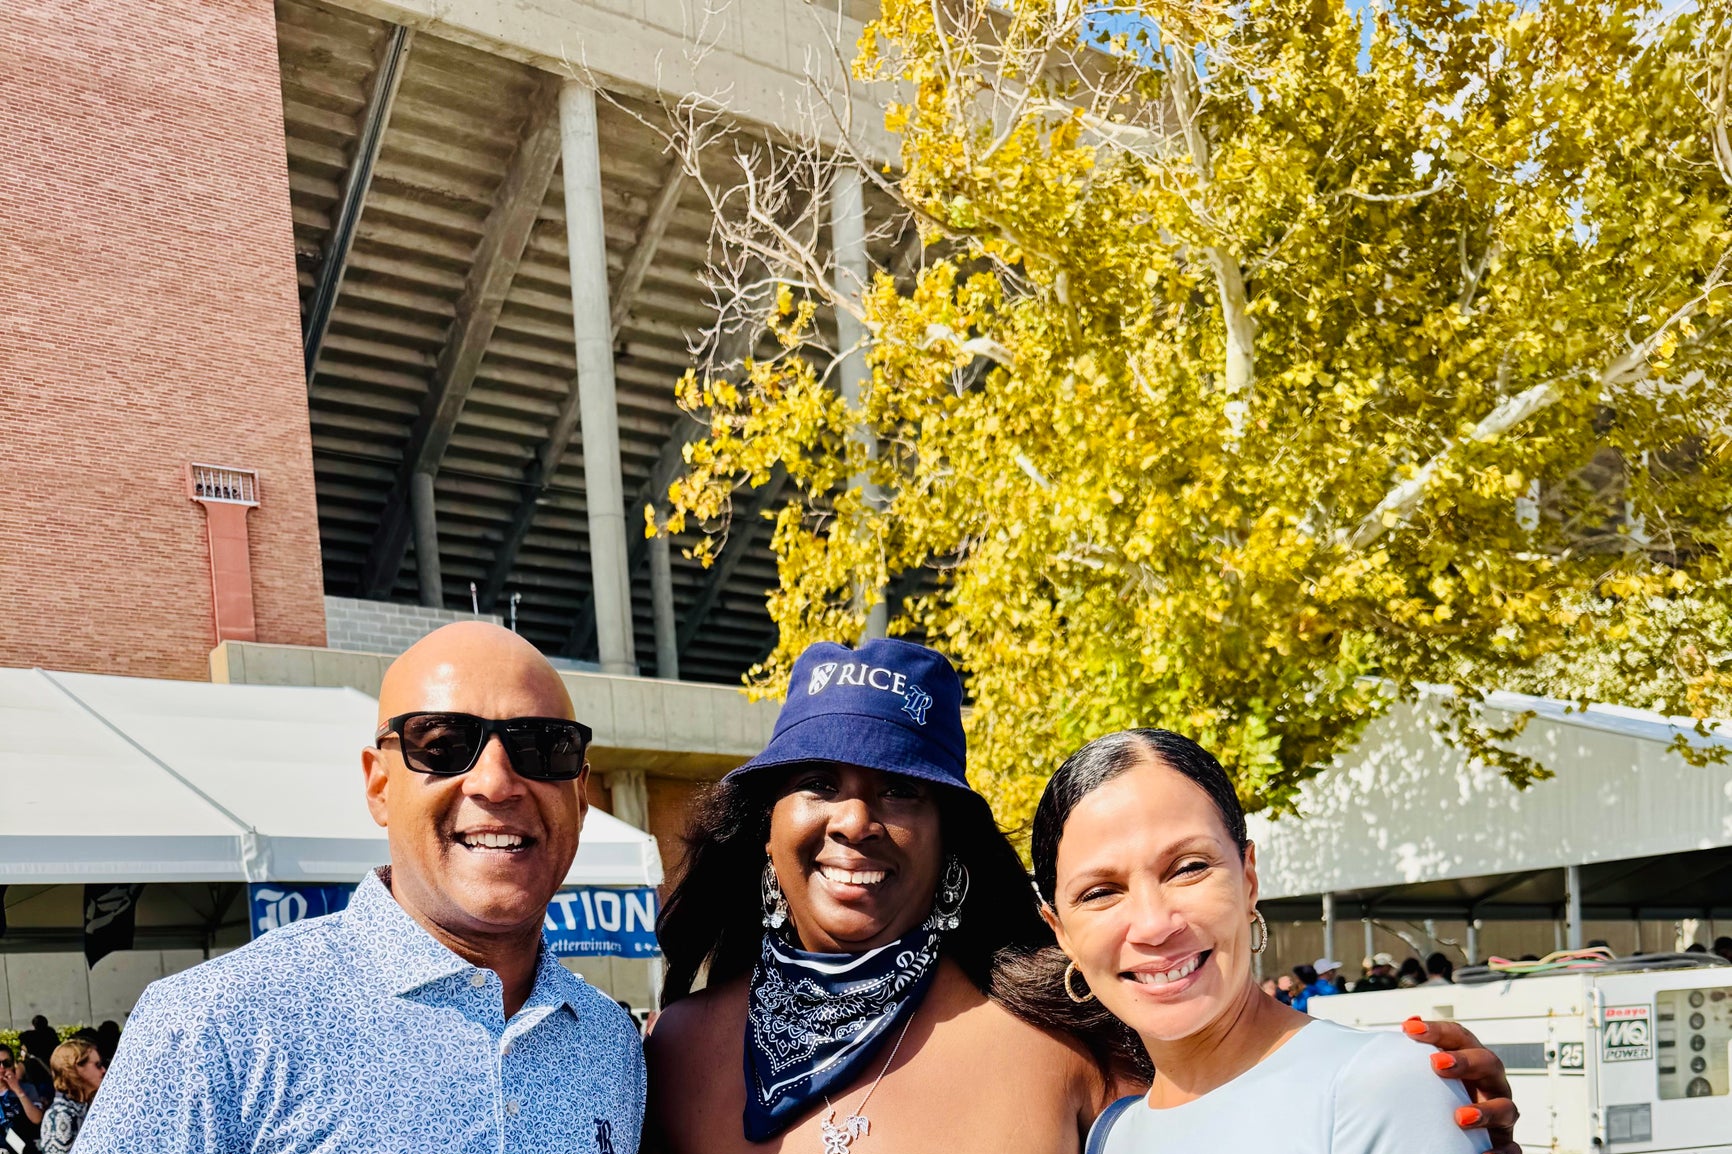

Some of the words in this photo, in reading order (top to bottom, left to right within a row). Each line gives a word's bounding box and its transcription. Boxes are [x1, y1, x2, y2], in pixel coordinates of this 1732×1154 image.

[836, 664, 907, 695] RICE
[550, 938, 622, 952] etterwinners
[1604, 1020, 1649, 1046] MQ
[1560, 1044, 1583, 1067] 25
[1606, 1048, 1649, 1059] POWER
